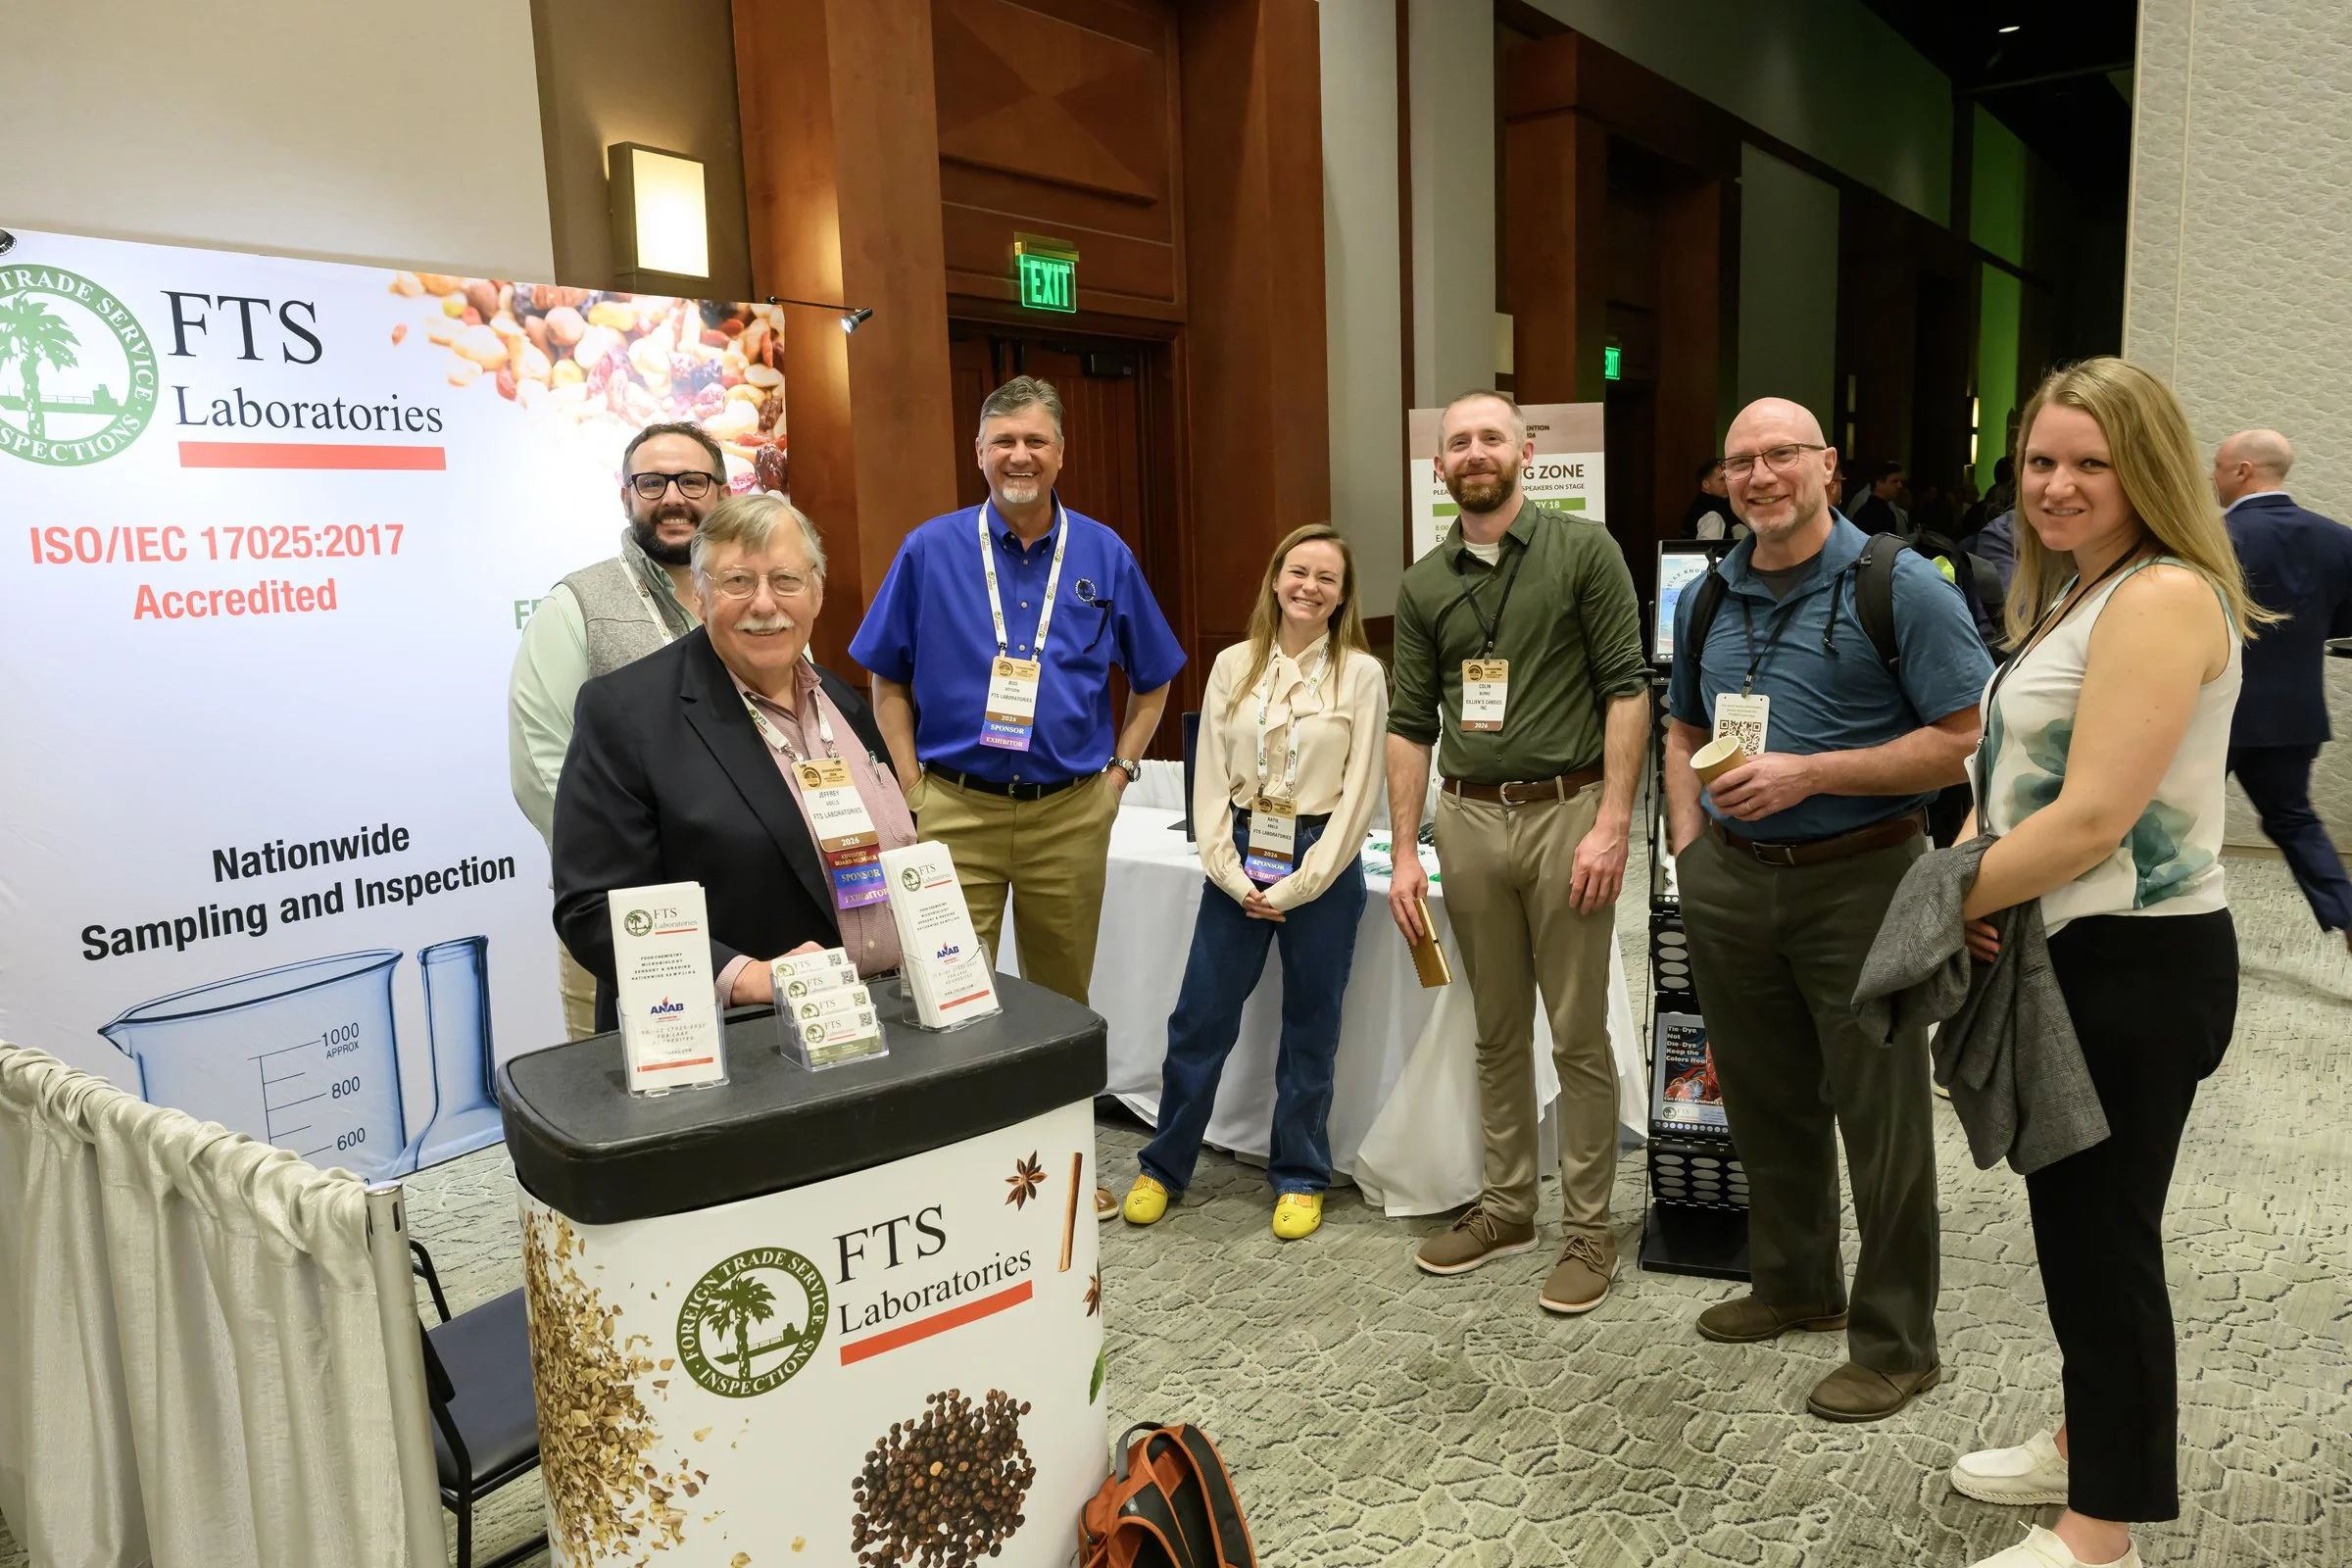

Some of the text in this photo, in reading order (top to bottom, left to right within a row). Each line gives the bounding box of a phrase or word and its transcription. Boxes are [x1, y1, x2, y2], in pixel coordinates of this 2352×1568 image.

[1031, 261, 1070, 307] EXIT
[160, 290, 323, 365] FTS
[0, 269, 155, 402] TRADE SERVICE
[171, 385, 444, 433] Laboratories
[1539, 464, 1585, 479] ZONE
[29, 523, 406, 565] ISO/IEC 17025:2017
[133, 578, 338, 620] Accredited
[990, 723, 1025, 735] SPONSOR
[986, 736, 1024, 748] EXHIBITOR
[818, 790, 840, 799] JEFFREY
[824, 807, 862, 819] LABORATORIES
[841, 836, 860, 847] 2026
[1261, 829, 1292, 841] LABORATORIES
[212, 822, 411, 883] Nationwide
[841, 850, 867, 859] ADVISORY
[853, 855, 878, 863] MEMBER
[918, 862, 937, 875] FTS
[1252, 858, 1285, 870] SPONSOR
[841, 868, 881, 883] SPONSOR
[80, 855, 516, 961] Sampling and Inspection
[654, 906, 678, 919] FTS
[654, 919, 698, 930] Laboratories
[937, 946, 959, 958] ANAB
[641, 958, 683, 967] MICROBIOLOGY
[794, 959, 811, 969] FTS
[807, 977, 823, 988] FTS
[651, 1003, 684, 1014] ANAB
[819, 999, 836, 1009] FTS
[824, 1019, 842, 1030] FTS
[320, 1022, 361, 1049] 1000
[325, 1041, 360, 1059] APPROX
[331, 1076, 362, 1100] 800
[336, 1127, 367, 1152] 600
[833, 1203, 947, 1285] FTS
[838, 1250, 1032, 1337] Laboratories
[680, 1250, 826, 1361] FOREIGN TRADE SERVICE
[698, 1339, 815, 1395] INSPECTIONS
